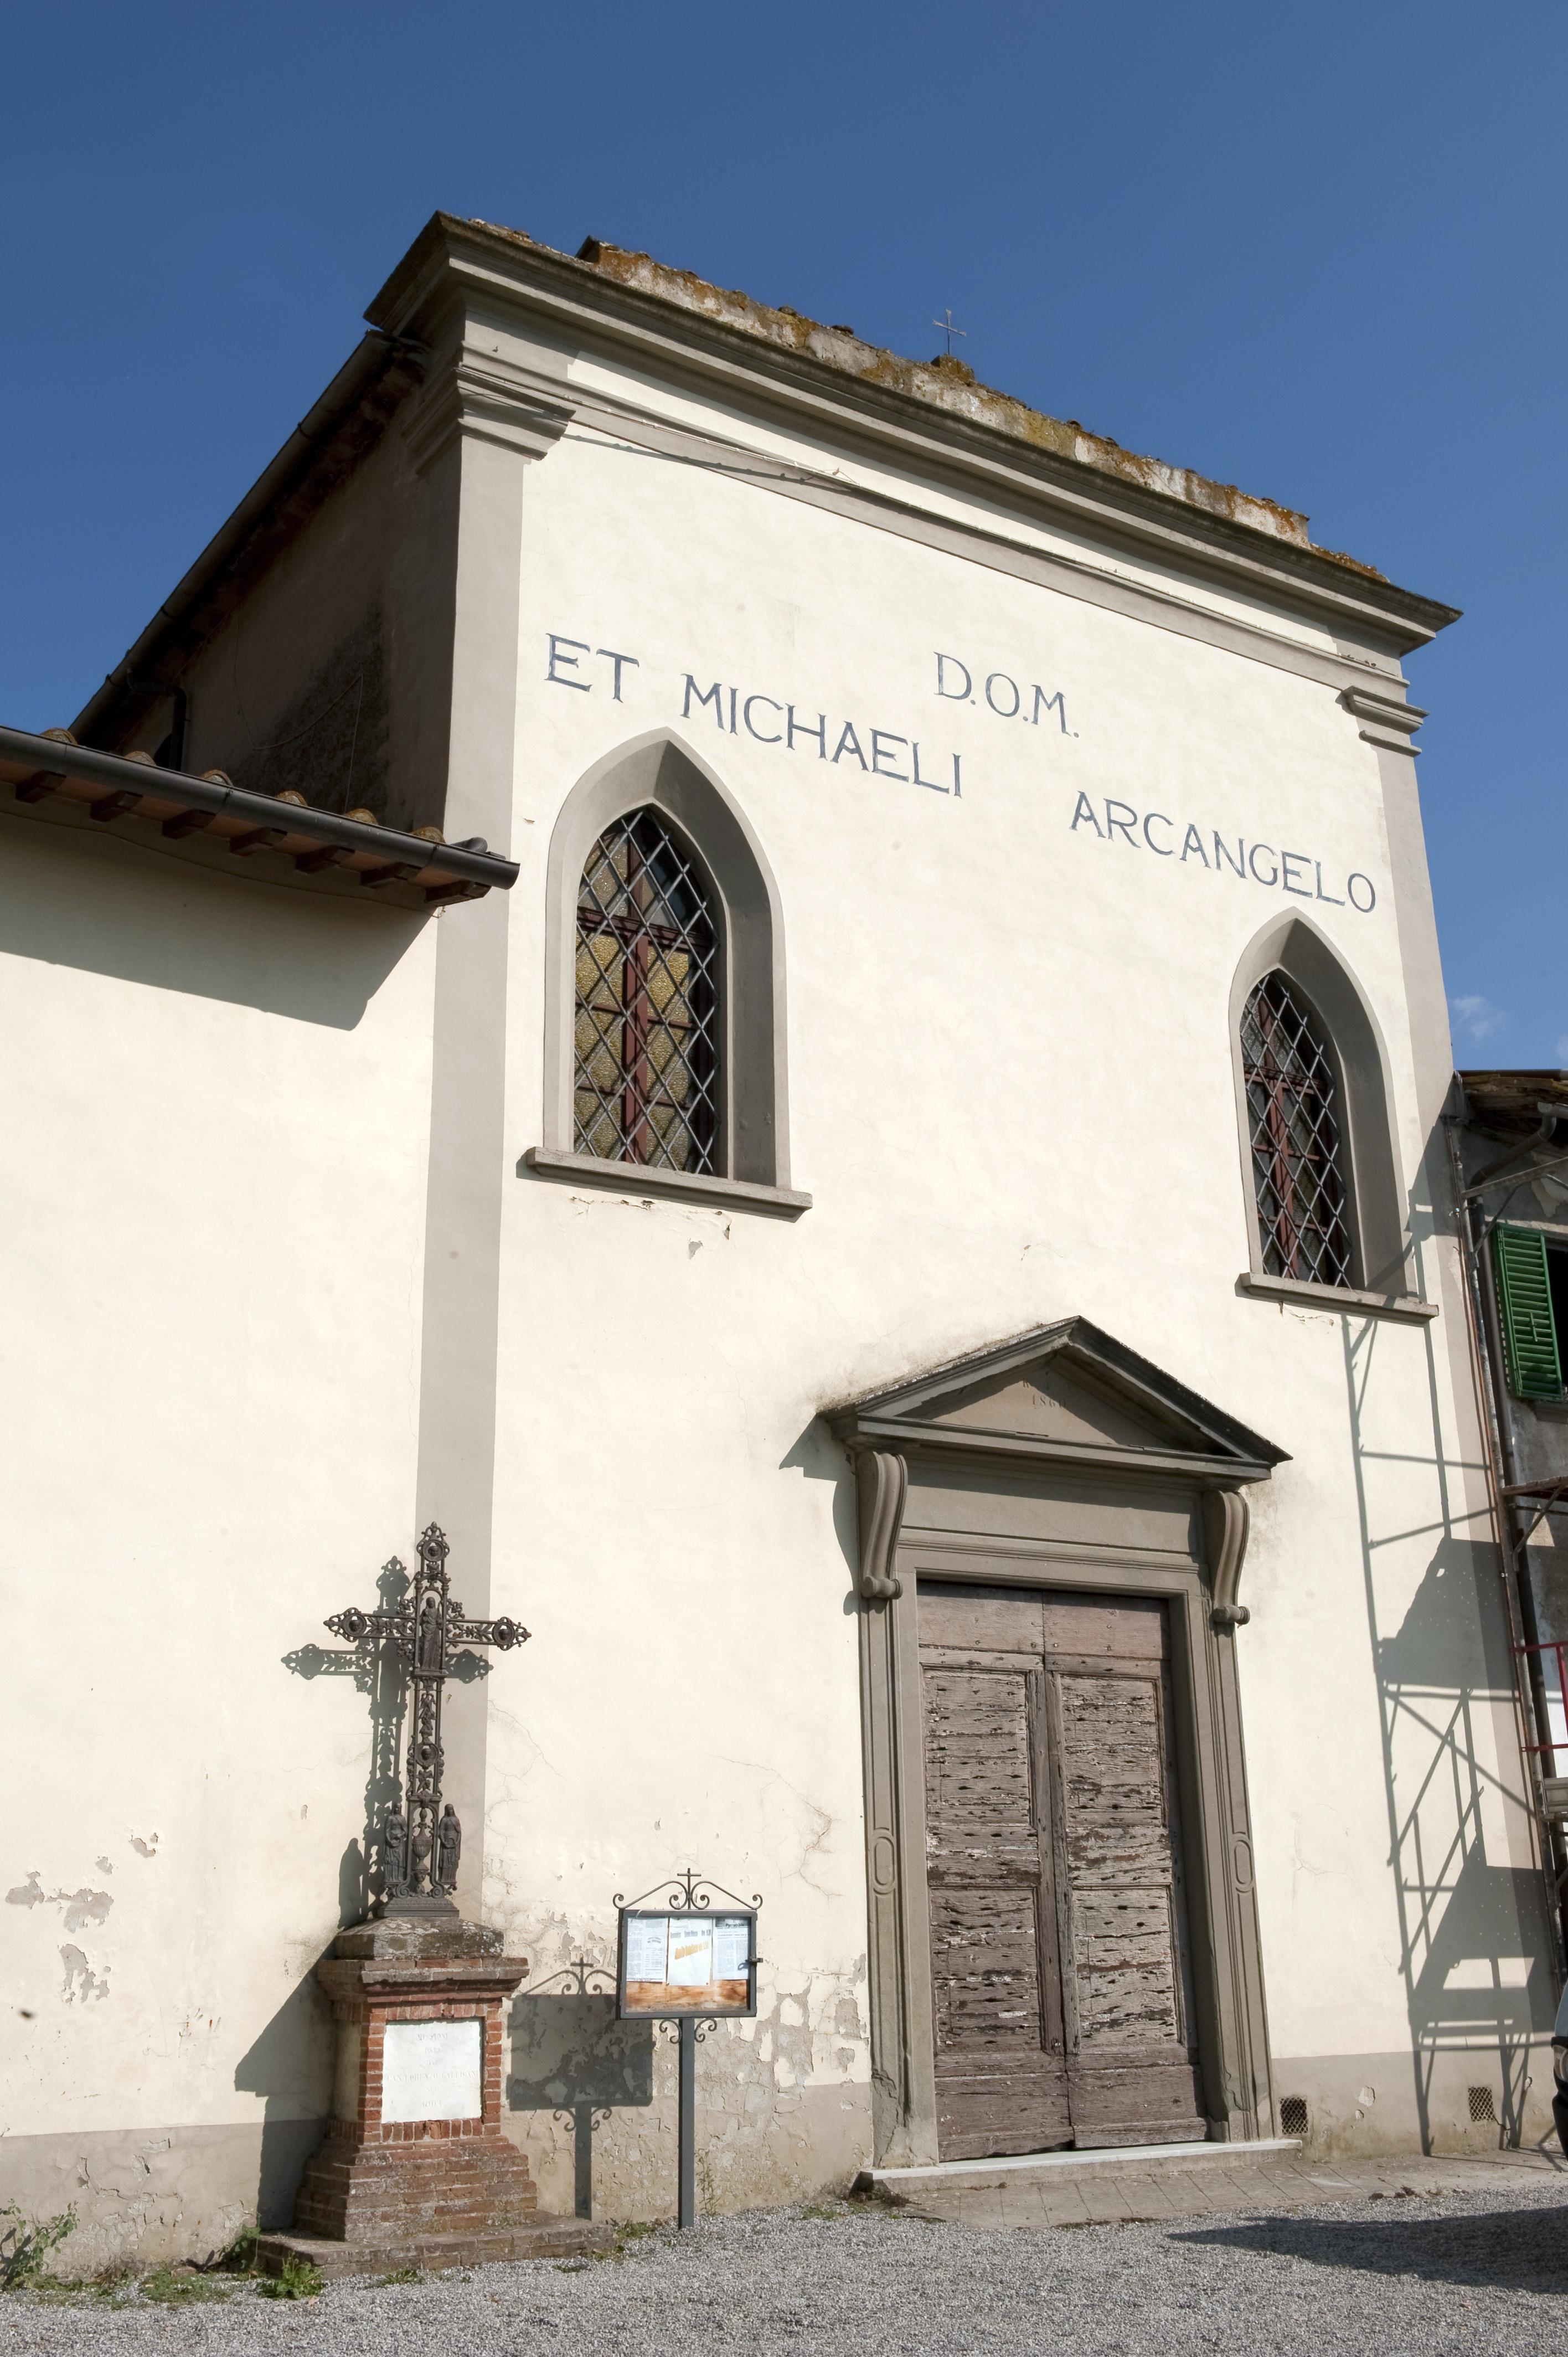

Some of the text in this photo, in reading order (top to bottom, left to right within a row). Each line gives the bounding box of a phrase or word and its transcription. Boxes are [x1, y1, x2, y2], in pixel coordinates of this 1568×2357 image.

[544, 633, 1376, 913] ET MICHAELI ARCANGELO
[933, 651, 1080, 739] D.O.M.
